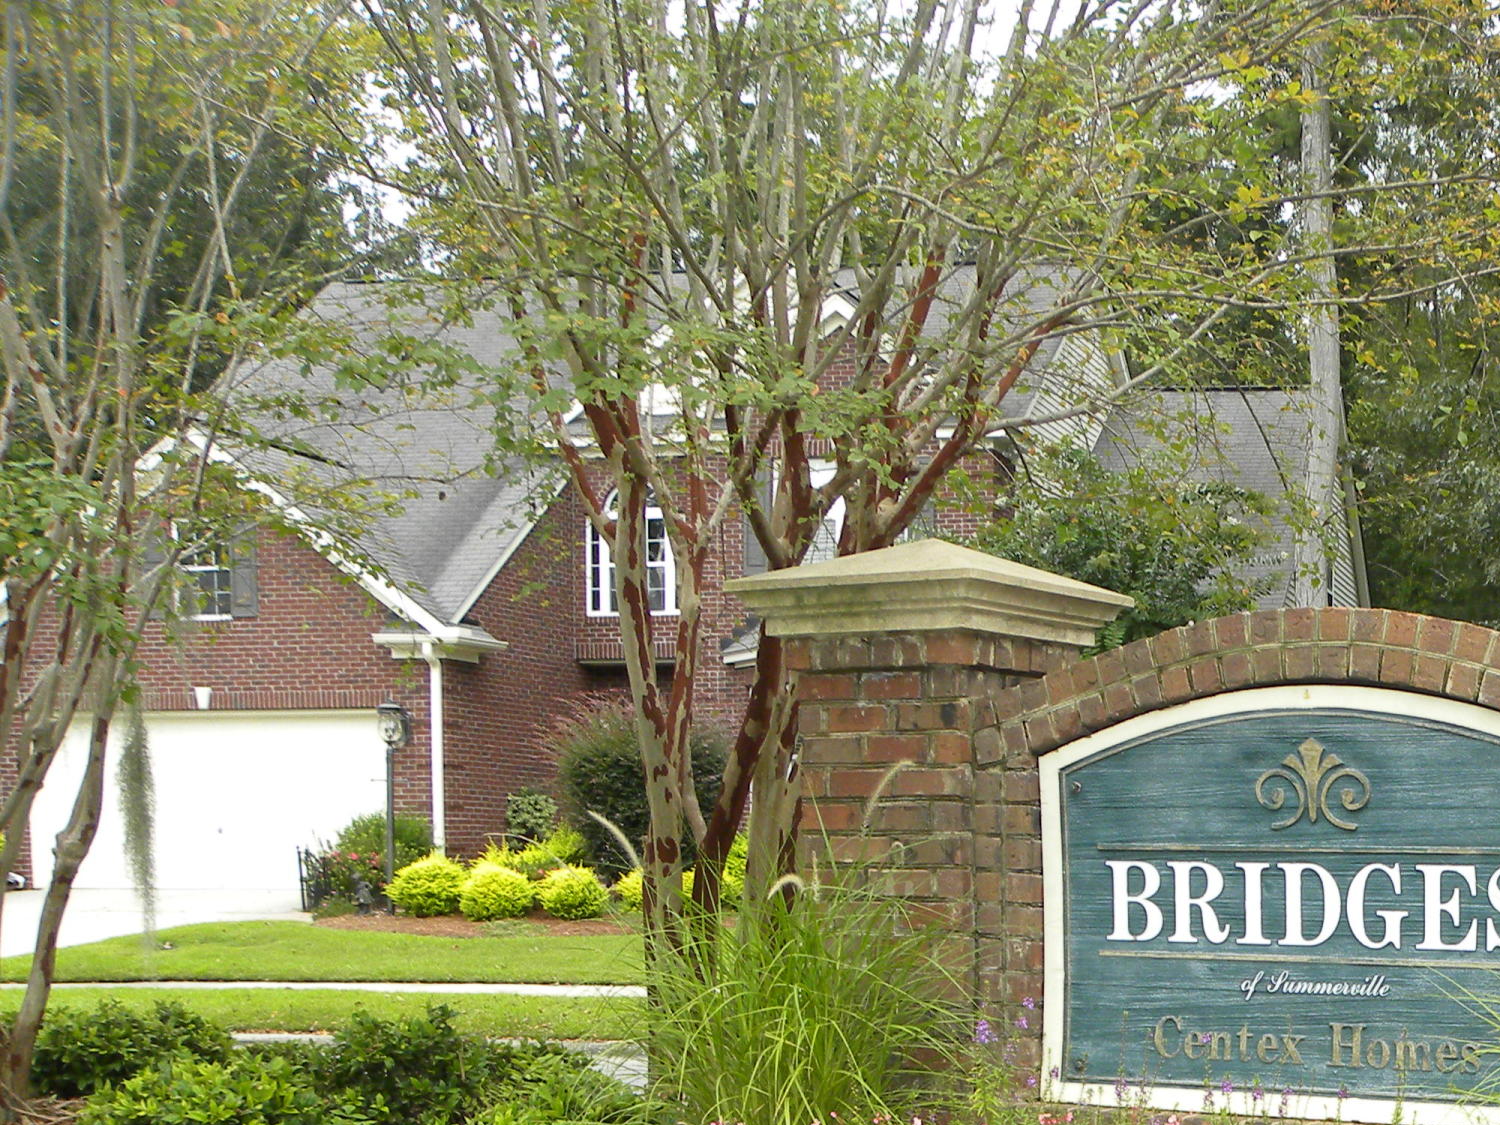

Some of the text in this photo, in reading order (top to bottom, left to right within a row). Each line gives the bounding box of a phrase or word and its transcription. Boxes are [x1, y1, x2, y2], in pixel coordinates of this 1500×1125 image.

[1240, 969, 1392, 1001] of Summerville
[1153, 1014, 1482, 1075] Centex Homes
